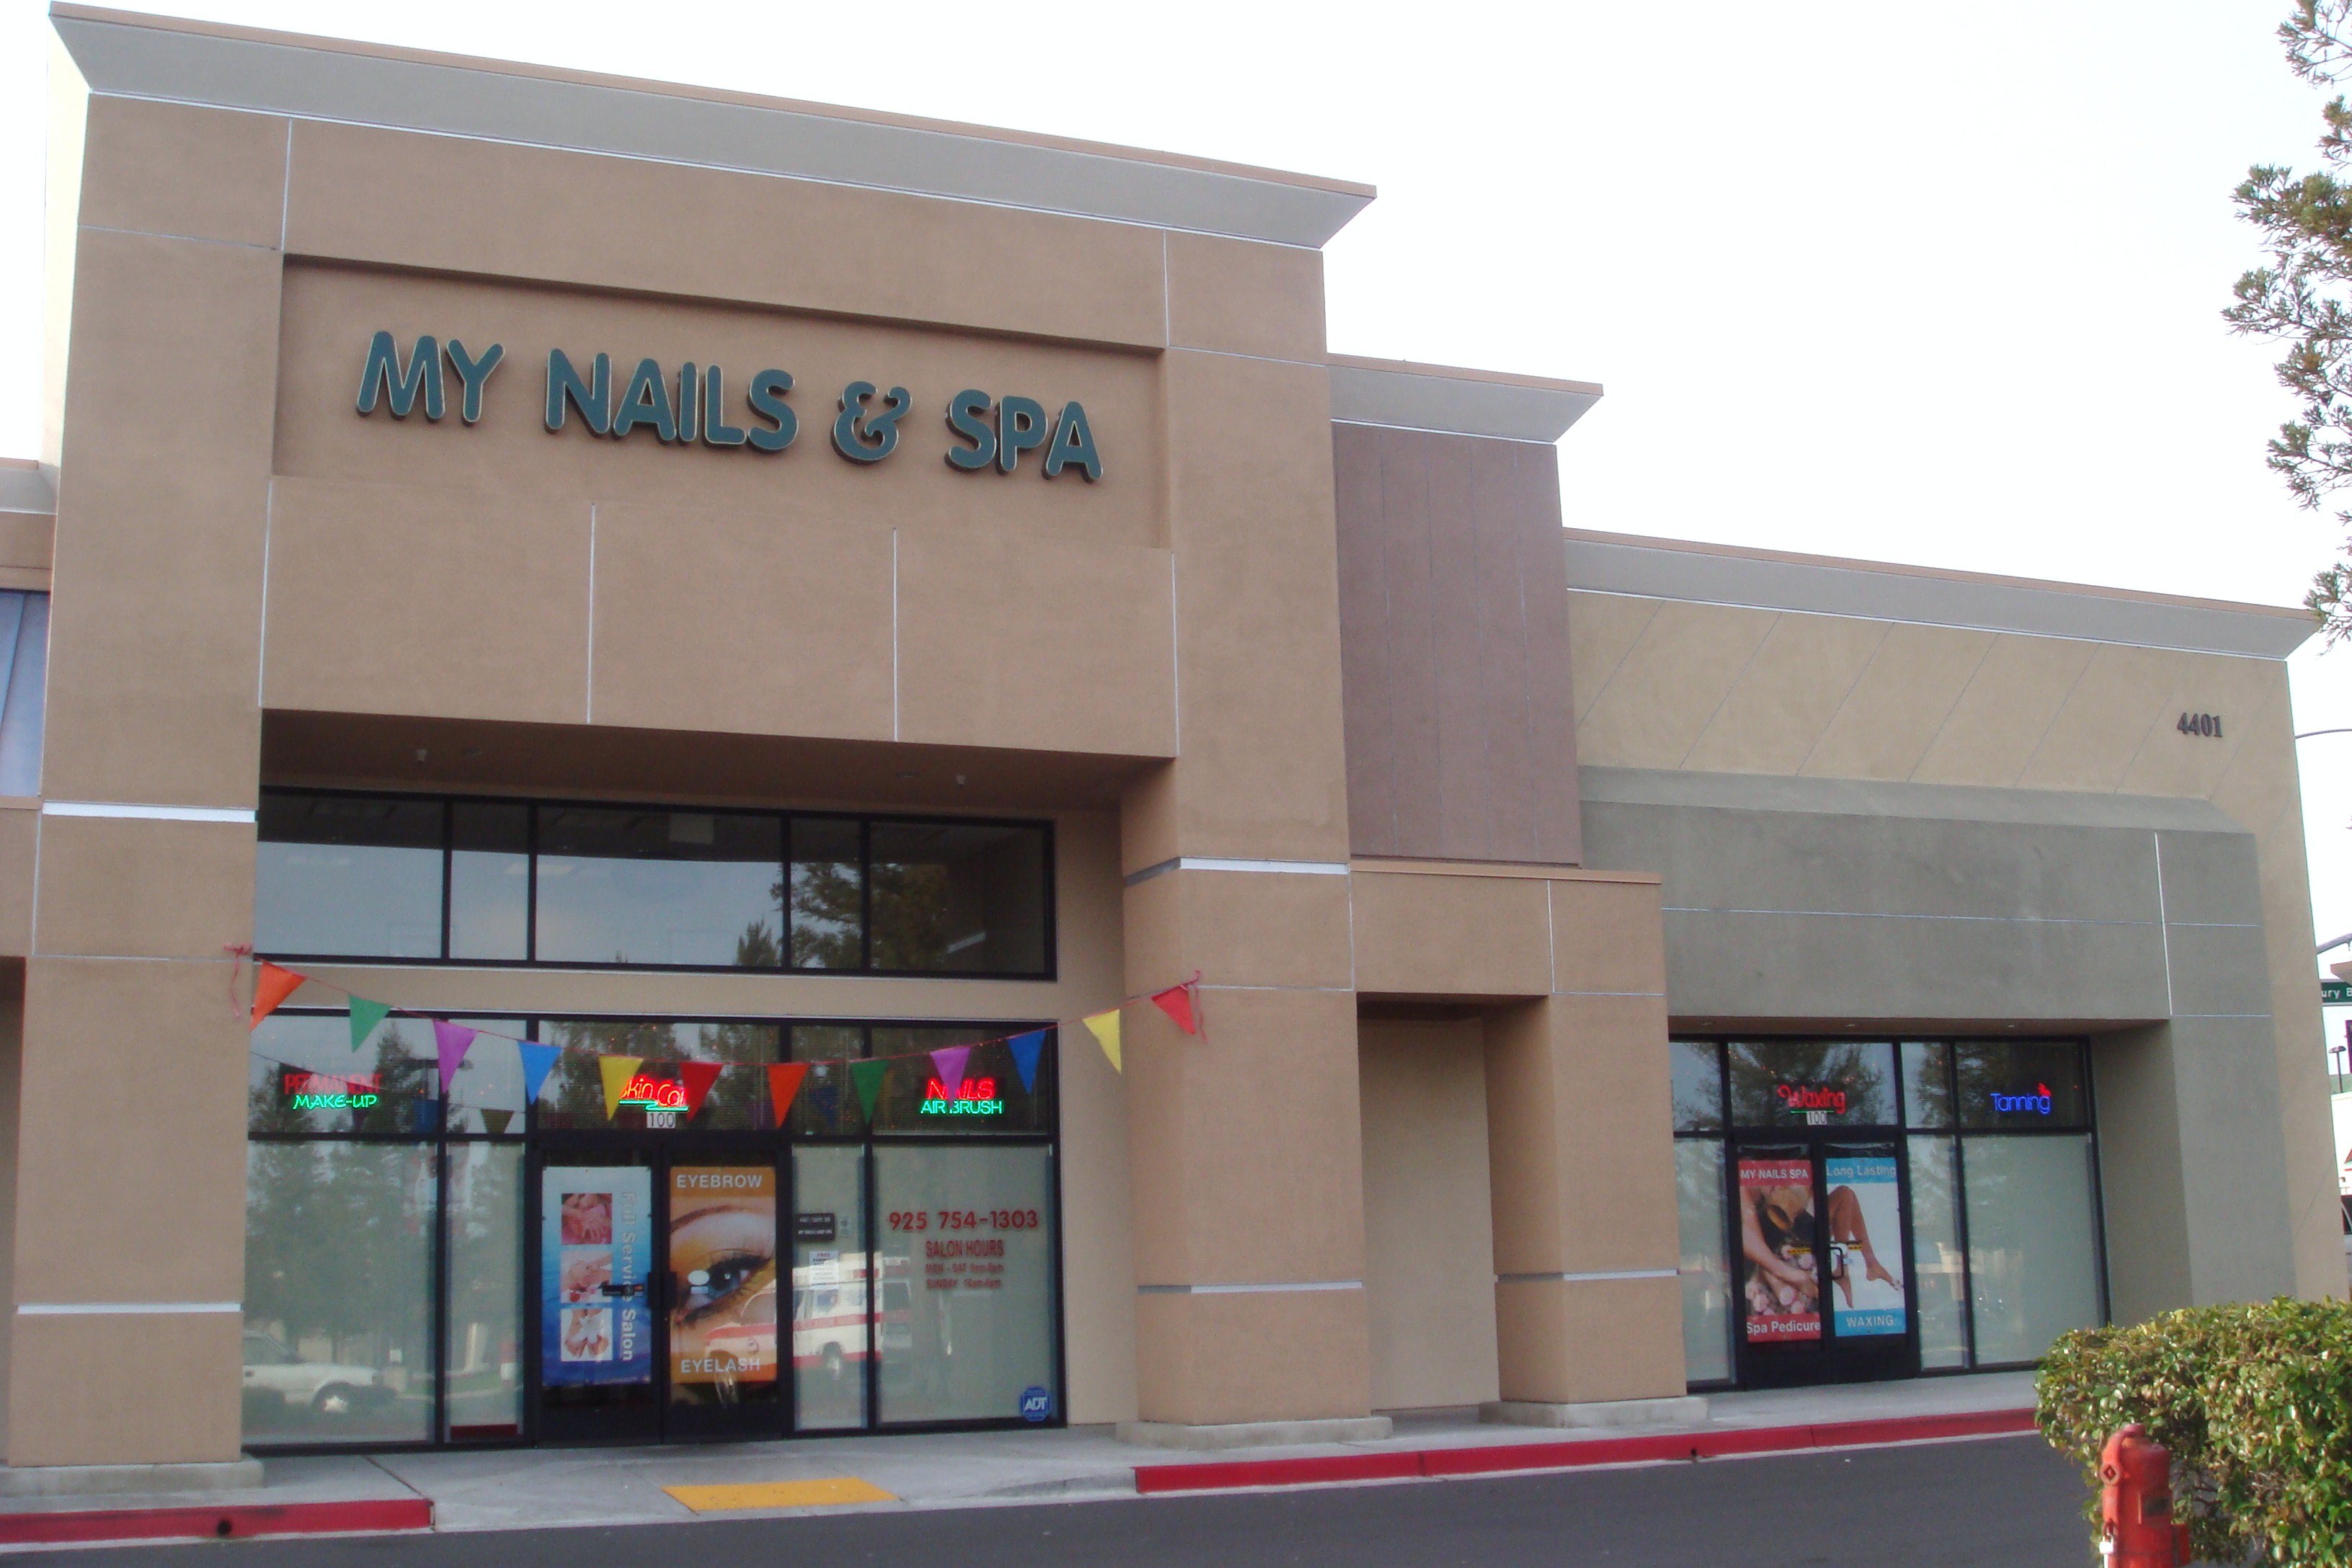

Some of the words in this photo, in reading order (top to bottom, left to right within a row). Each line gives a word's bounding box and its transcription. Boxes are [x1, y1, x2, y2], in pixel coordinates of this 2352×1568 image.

[357, 330, 504, 425] MY
[544, 348, 800, 453] NAILS
[830, 380, 912, 465] &
[945, 389, 1104, 484] SPA
[2177, 712, 2223, 738] 4401
[293, 1094, 378, 1110] MAKE-UP
[1777, 1084, 1846, 1115] Waxing
[1990, 1092, 2051, 1115] Tanning
[920, 1100, 947, 1115] AIR
[648, 1113, 674, 1128] 100
[1809, 1111, 1827, 1124] 100
[1740, 1170, 1755, 1180] MY
[1758, 1169, 1787, 1180] NAILS
[1789, 1168, 1808, 1179] SPA
[1826, 1164, 1854, 1178] Long
[1857, 1164, 1897, 1177] Lasting
[676, 1174, 762, 1188] EYEBROW
[888, 1211, 928, 1231] 925
[938, 1209, 1038, 1229] 754-1303
[925, 1239, 963, 1257] SALON
[966, 1239, 1004, 1257] HOURS
[1747, 1322, 1768, 1335] Spa
[1771, 1319, 1821, 1332] Pedicure
[1846, 1314, 1894, 1327] WAXING
[622, 1308, 636, 1361] Salon
[681, 1358, 761, 1373] EYELASH
[1024, 1396, 1048, 1411] ADT
